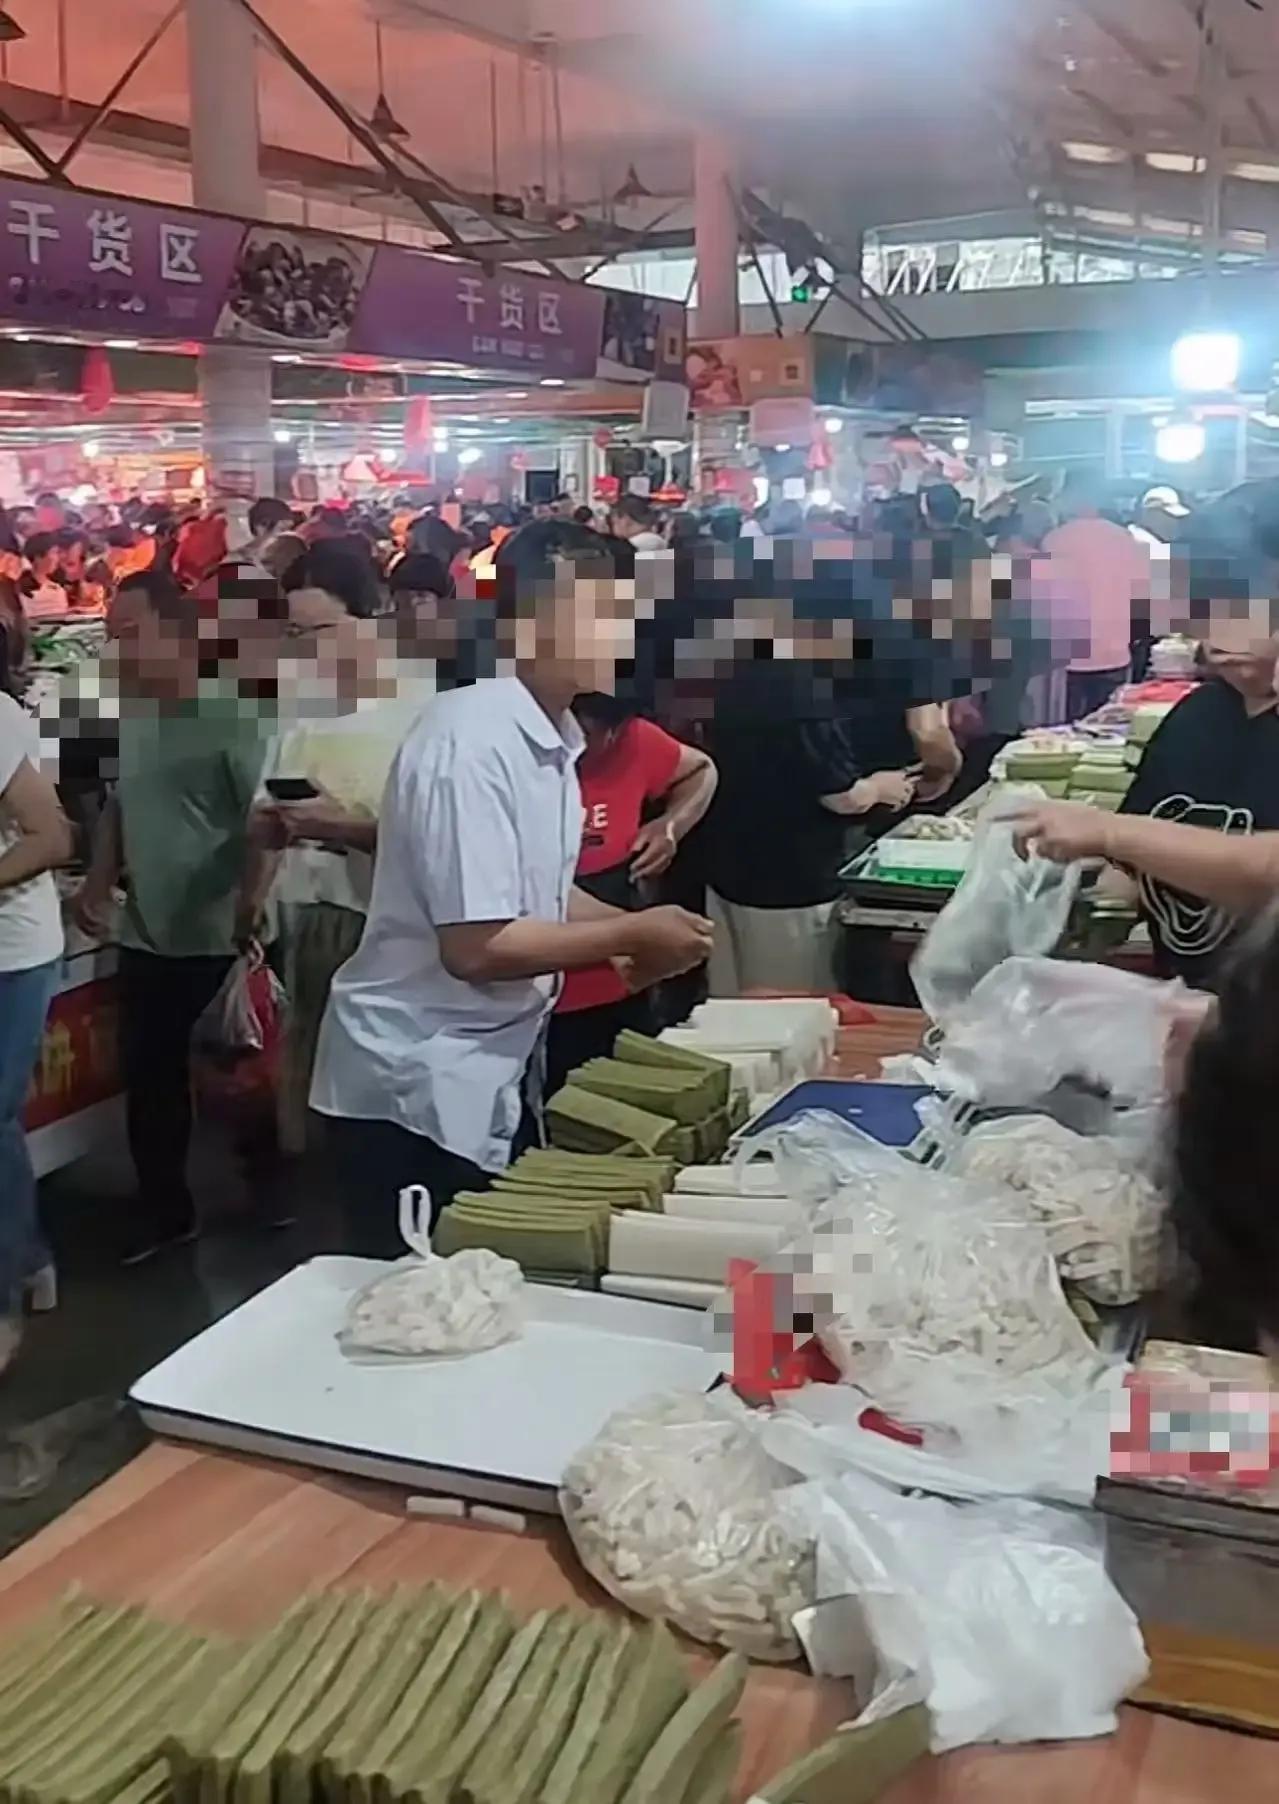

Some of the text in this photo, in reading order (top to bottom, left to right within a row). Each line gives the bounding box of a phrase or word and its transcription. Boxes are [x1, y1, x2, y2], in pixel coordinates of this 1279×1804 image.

[7, 200, 203, 283] 干货区
[456, 277, 563, 335] 干货区
